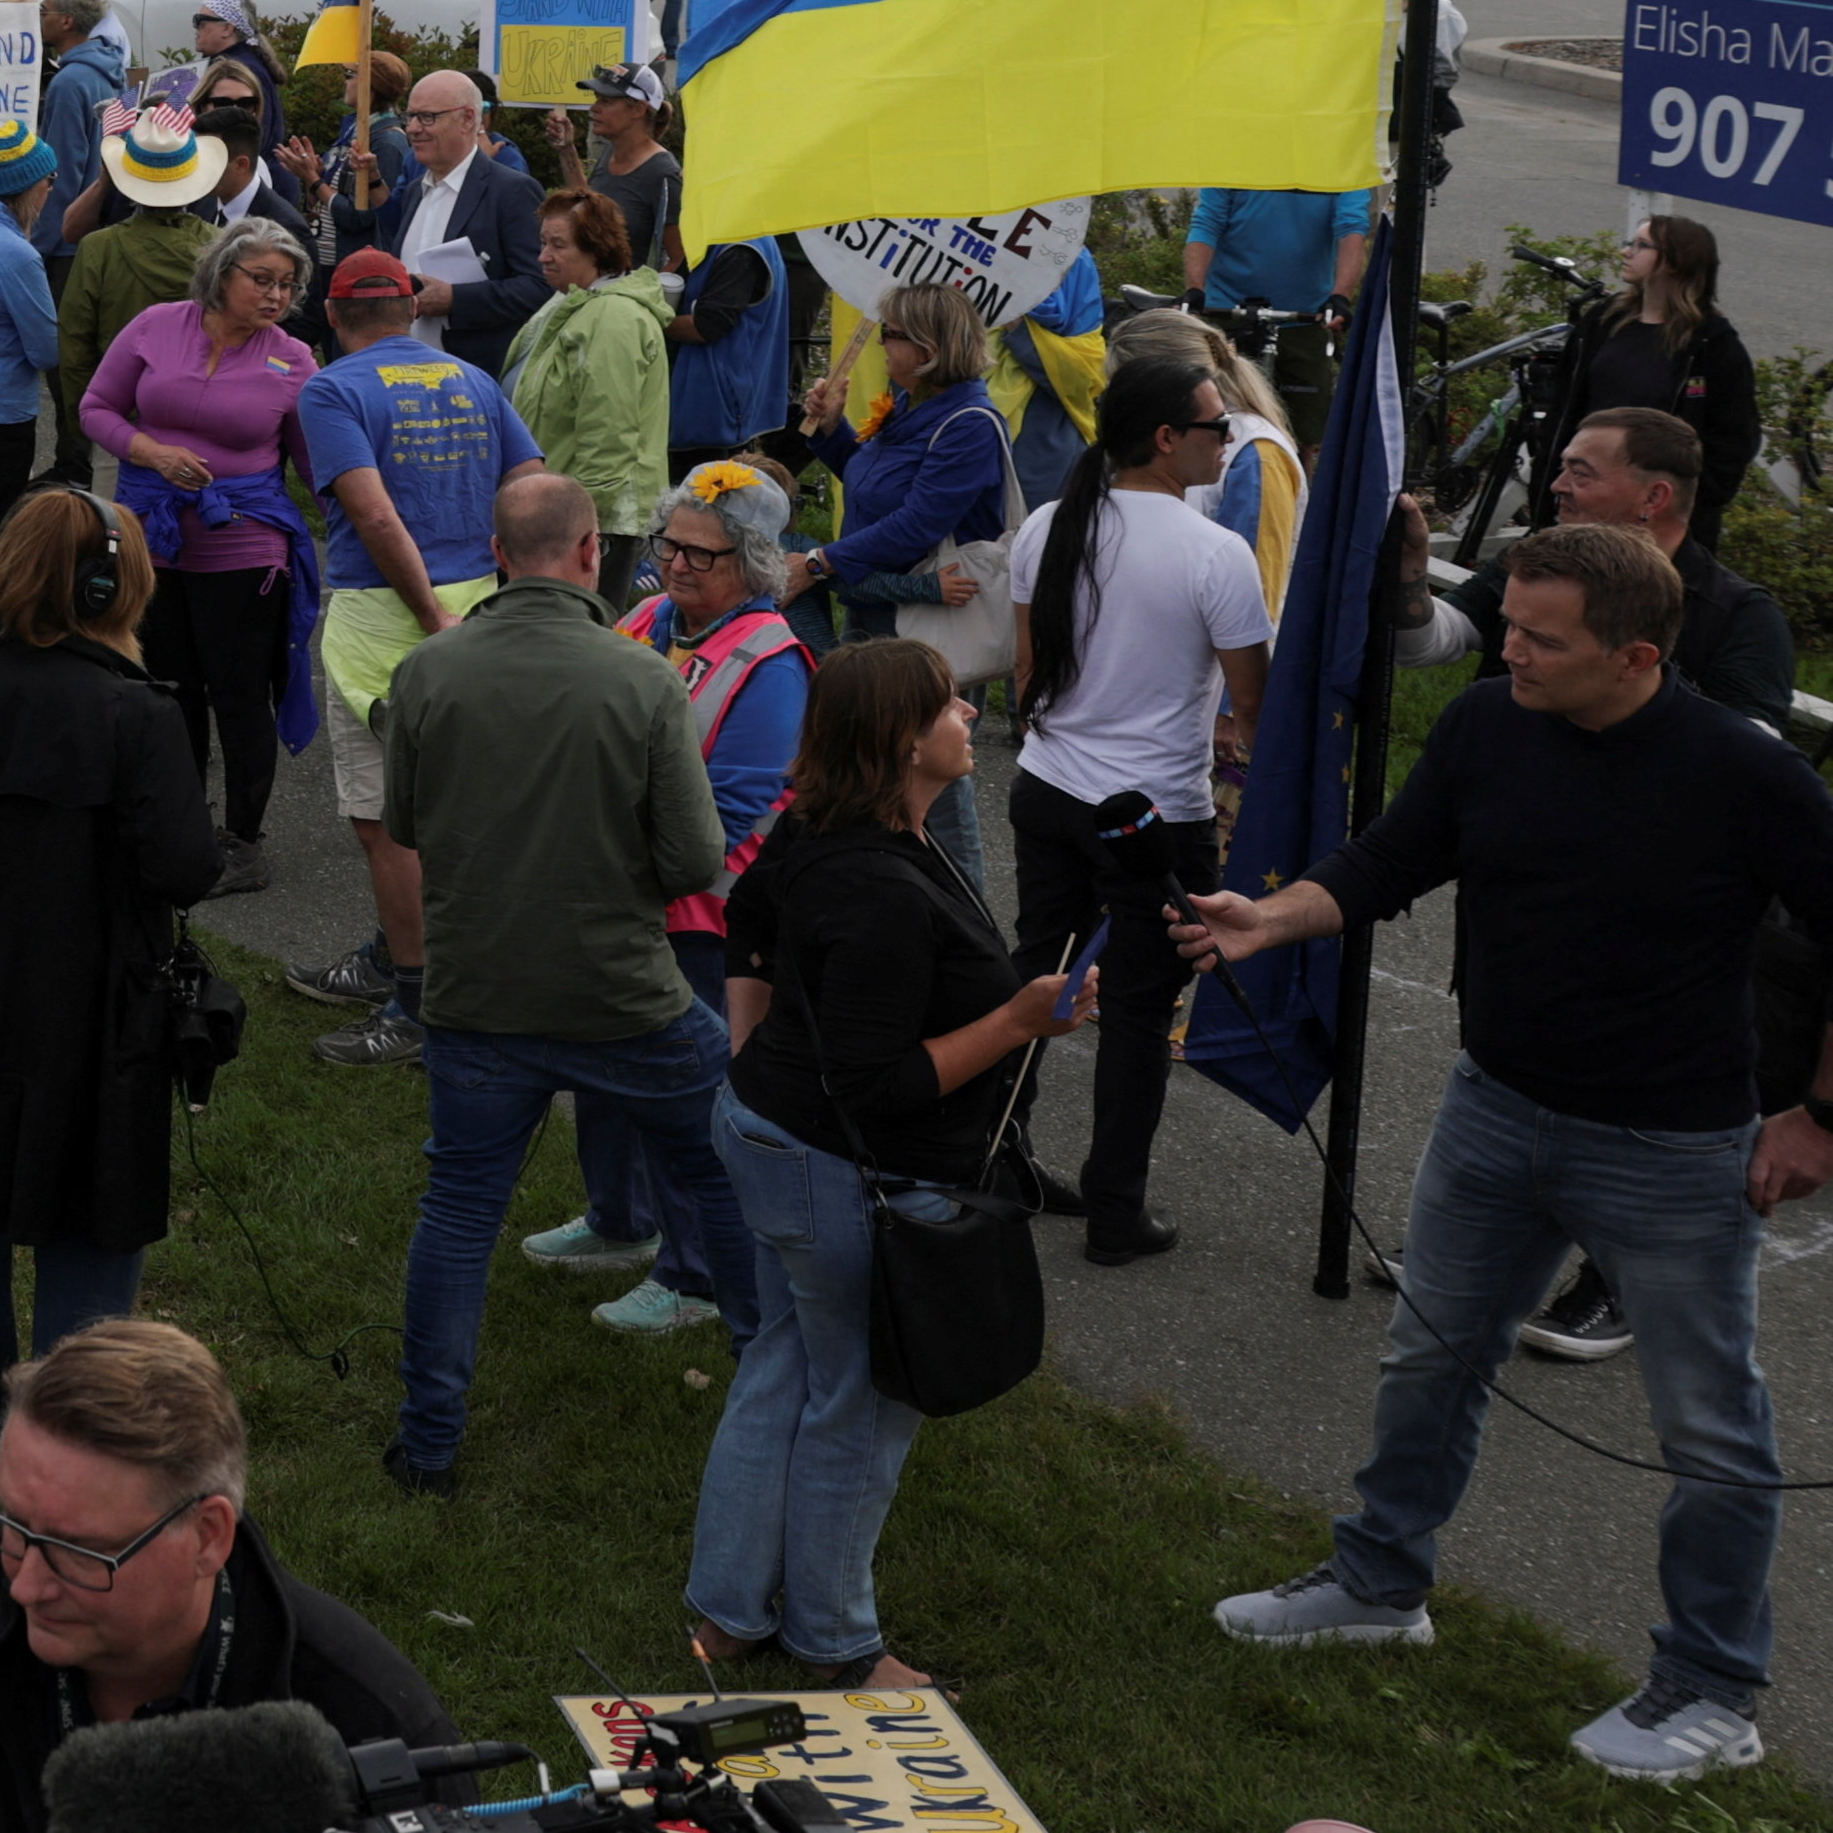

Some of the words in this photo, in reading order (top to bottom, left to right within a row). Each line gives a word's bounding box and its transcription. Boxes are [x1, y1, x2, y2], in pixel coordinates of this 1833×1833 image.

[1633, 4, 1752, 65] Elisha
[1649, 86, 1805, 187] 907
[949, 224, 997, 268] THE
